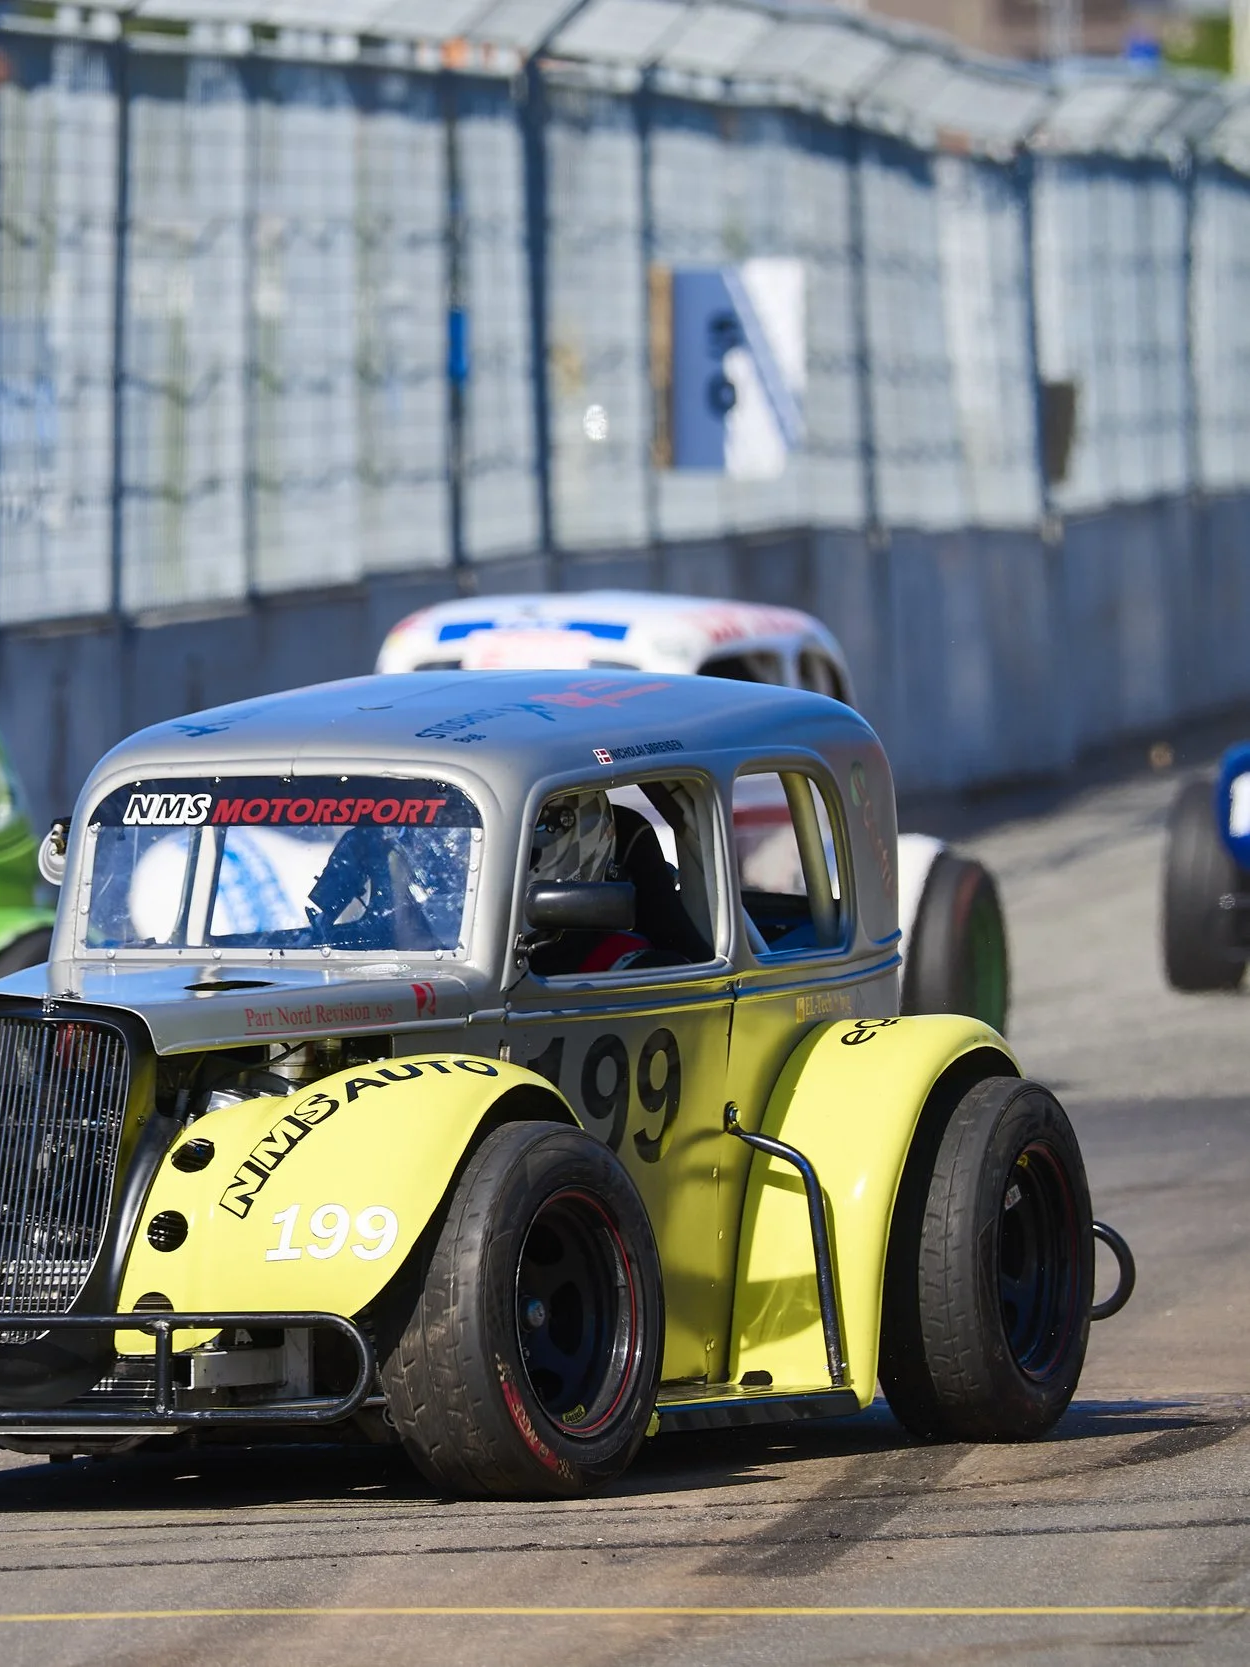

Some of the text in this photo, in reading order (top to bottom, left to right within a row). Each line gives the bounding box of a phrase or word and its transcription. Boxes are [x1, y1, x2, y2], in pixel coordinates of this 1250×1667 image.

[123, 793, 447, 825] NMS MOTORSPORT
[244, 1002, 393, 1027] Part Nord Revision ApS
[219, 1059, 500, 1220] NMS AUTO
[265, 1203, 399, 1263] 199
